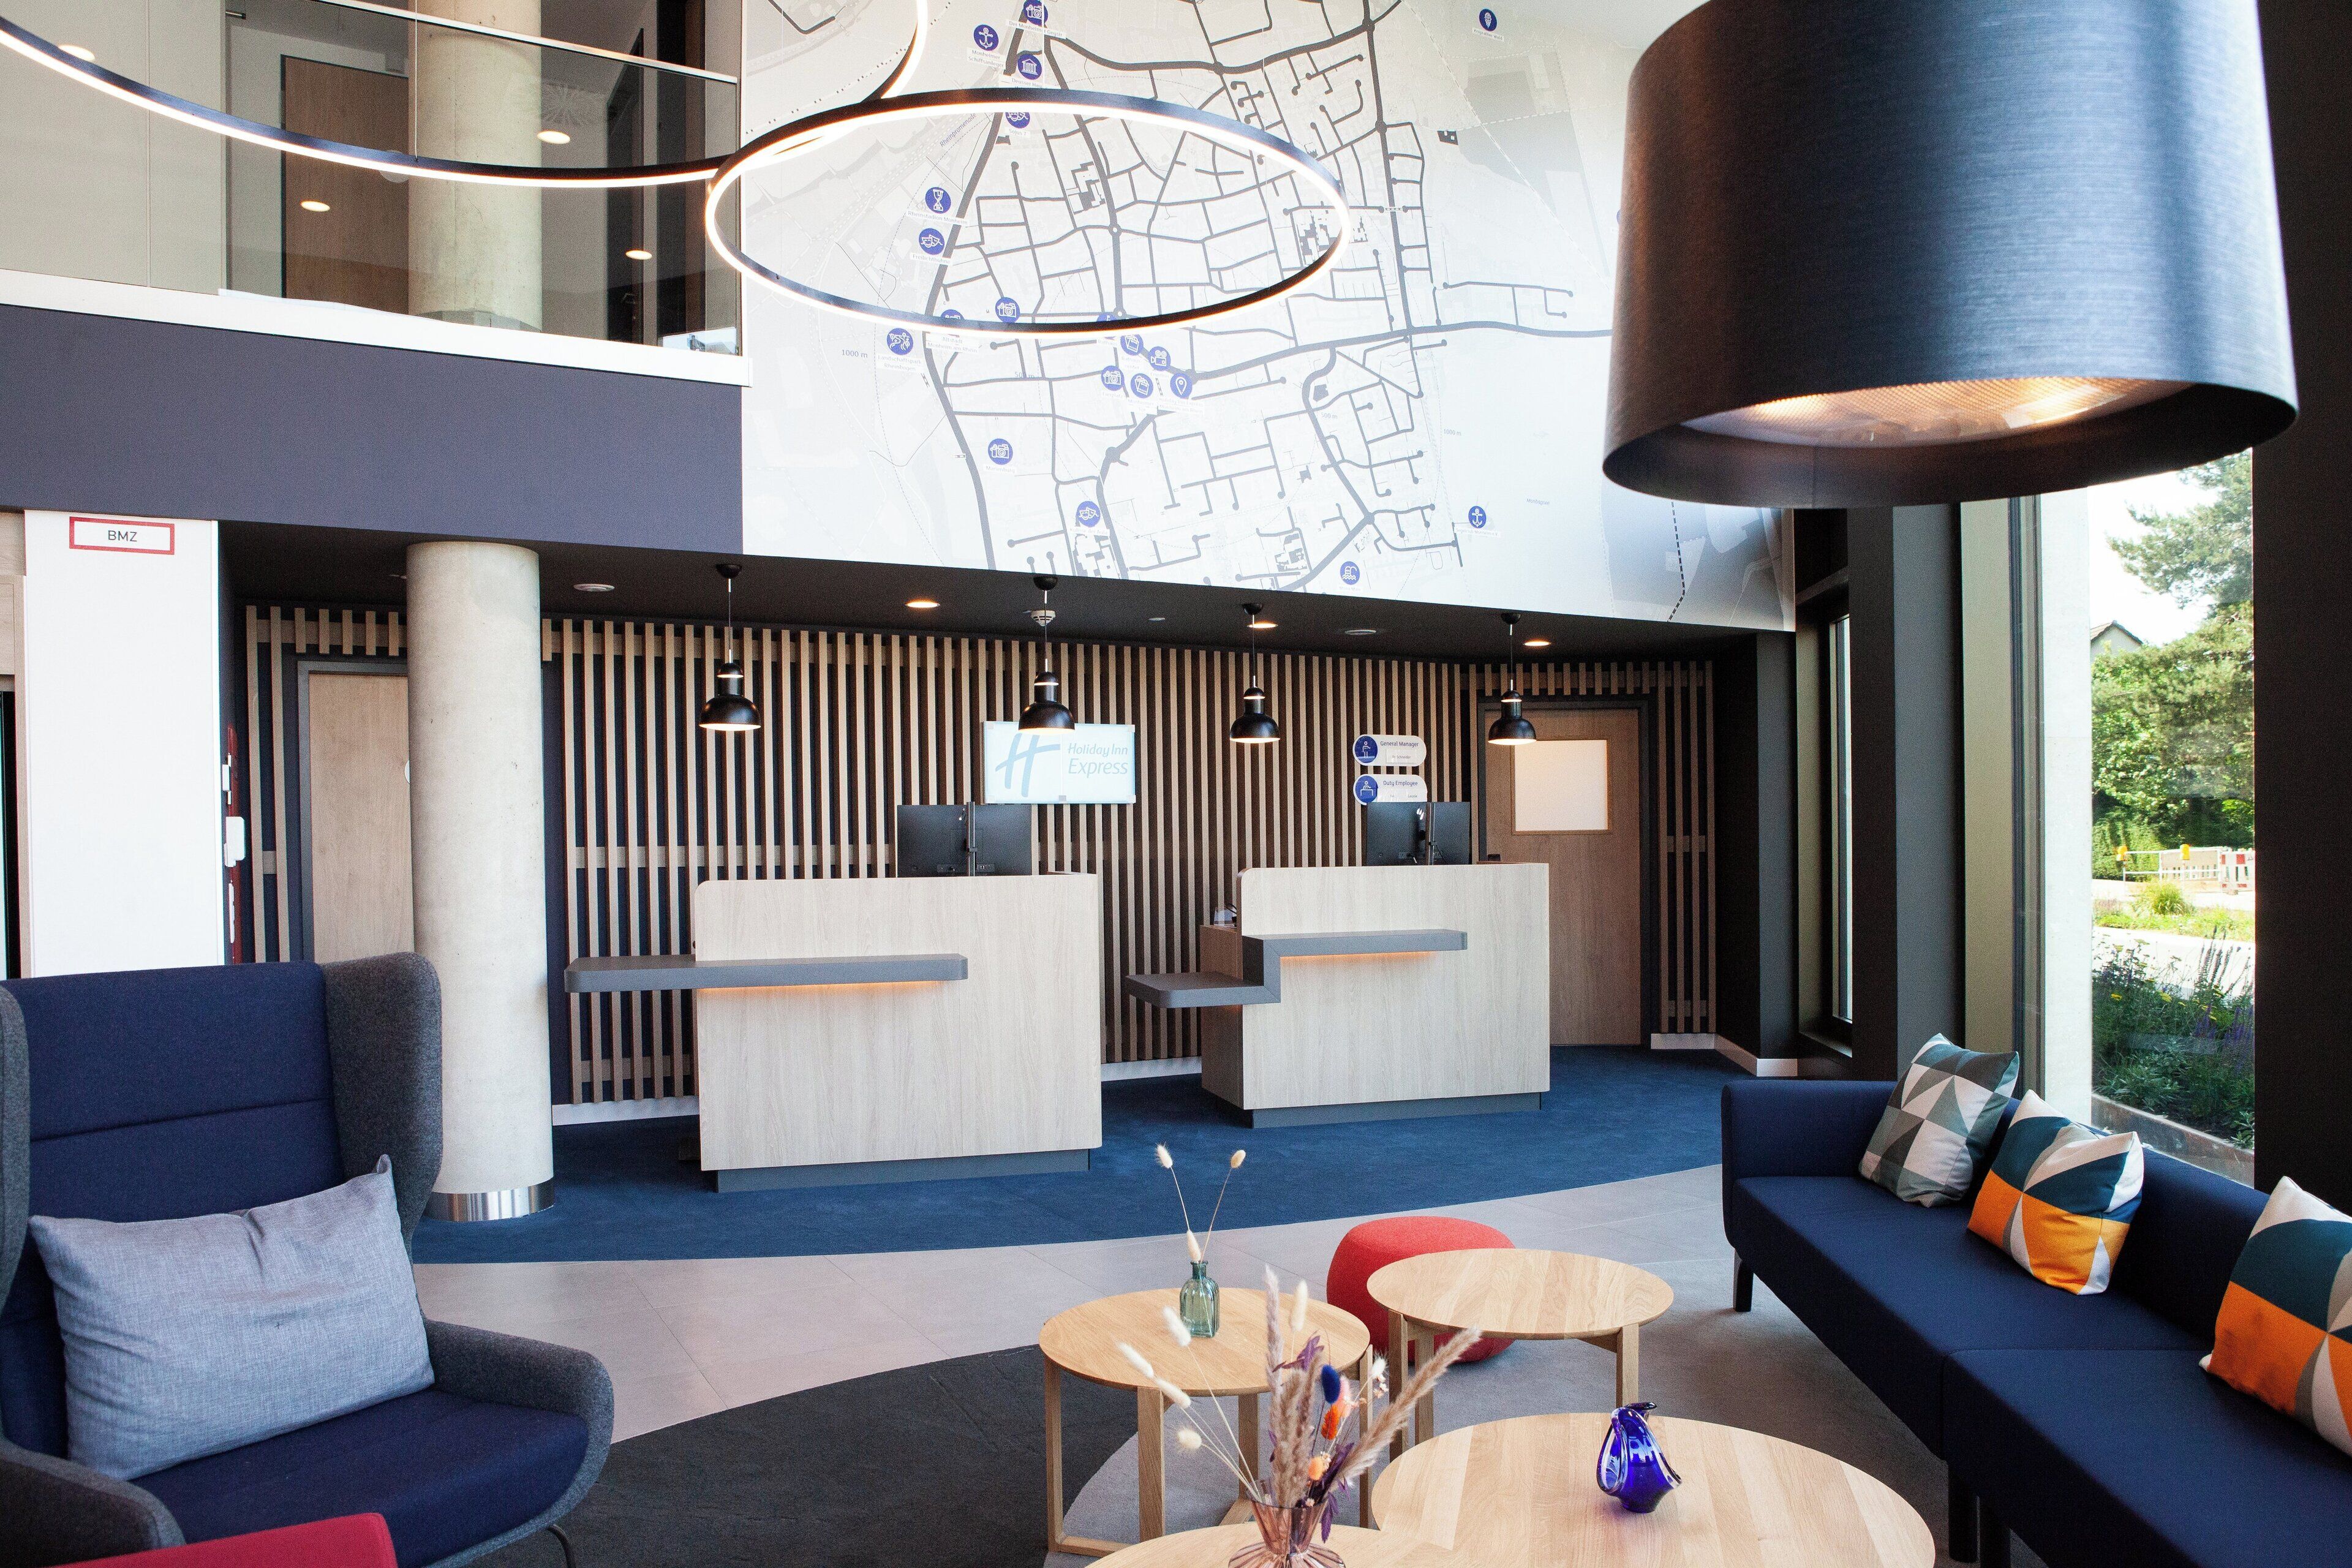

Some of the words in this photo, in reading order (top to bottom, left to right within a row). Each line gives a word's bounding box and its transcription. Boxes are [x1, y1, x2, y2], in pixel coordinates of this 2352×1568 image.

[940, 113, 976, 147] Rheinpromenade
[908, 211, 943, 221] Rheinstadion
[108, 530, 137, 542] BMZ
[1068, 743, 1110, 757] Holiday
[1112, 744, 1128, 755] Inn
[1068, 758, 1128, 778] Express
